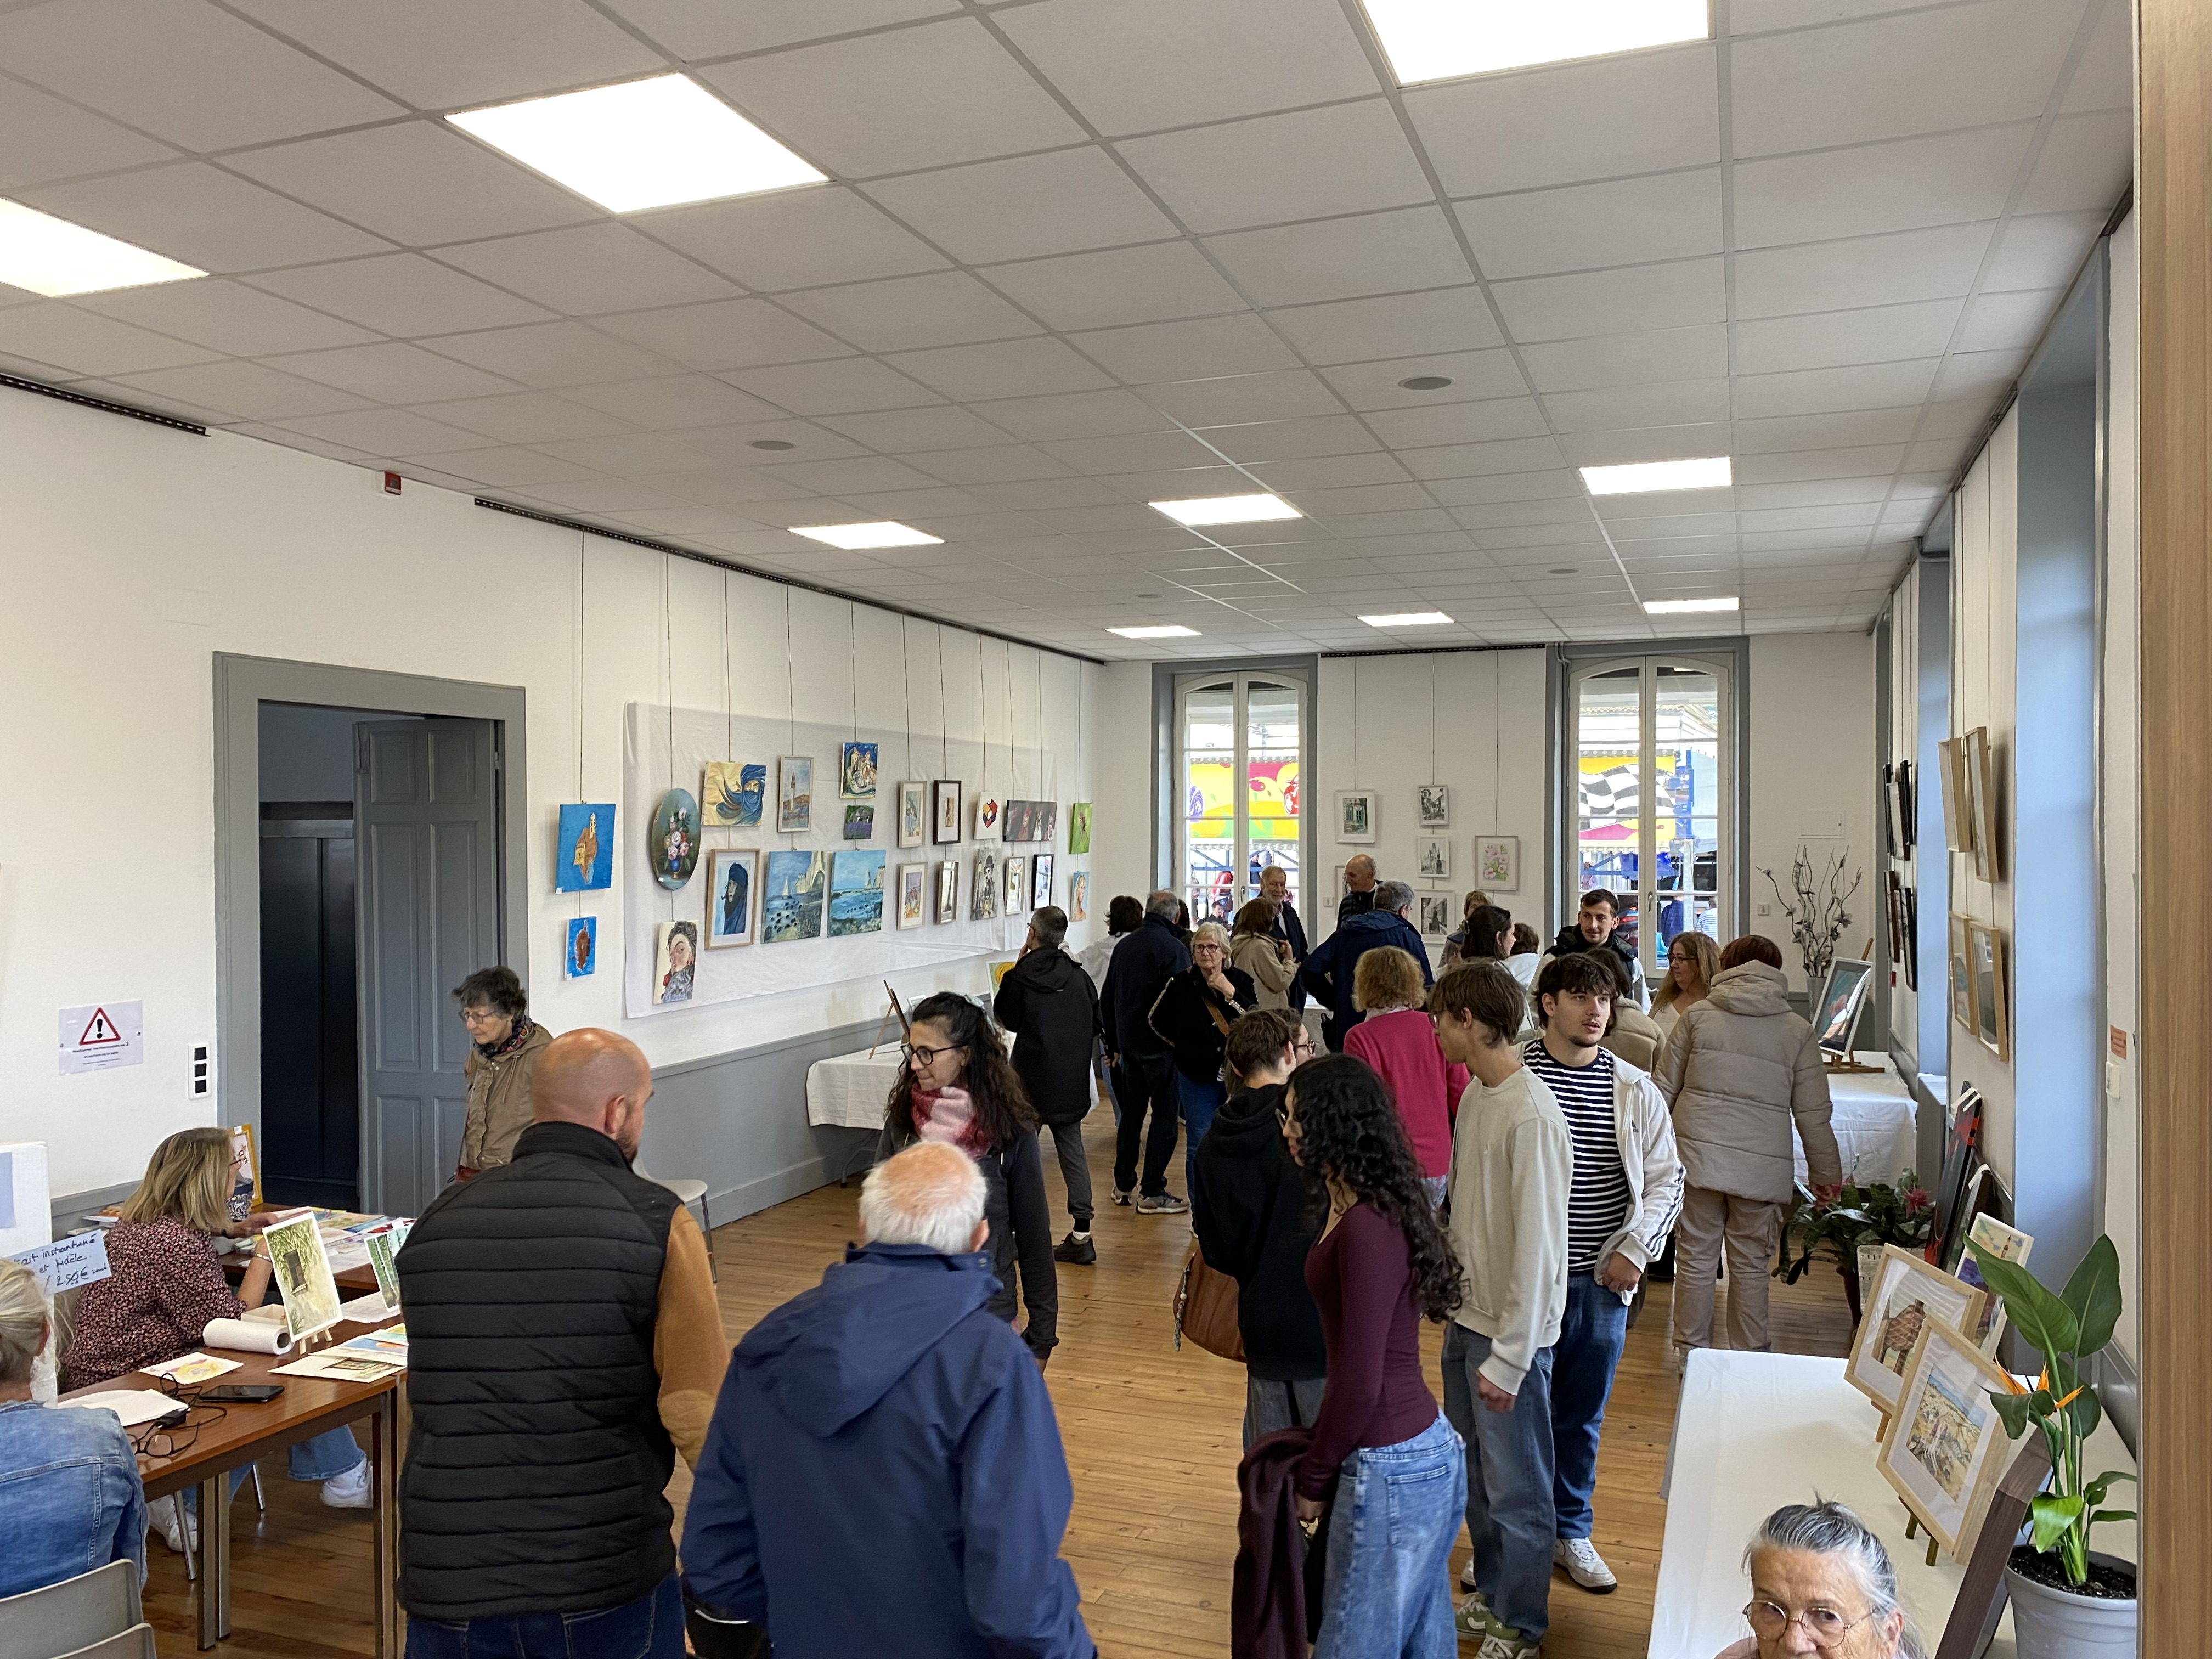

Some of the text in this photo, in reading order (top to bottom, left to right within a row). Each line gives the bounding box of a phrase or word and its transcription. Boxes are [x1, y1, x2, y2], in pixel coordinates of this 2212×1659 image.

[42, 1233, 97, 1259] instantané
[40, 1254, 87, 1274] et fidèle
